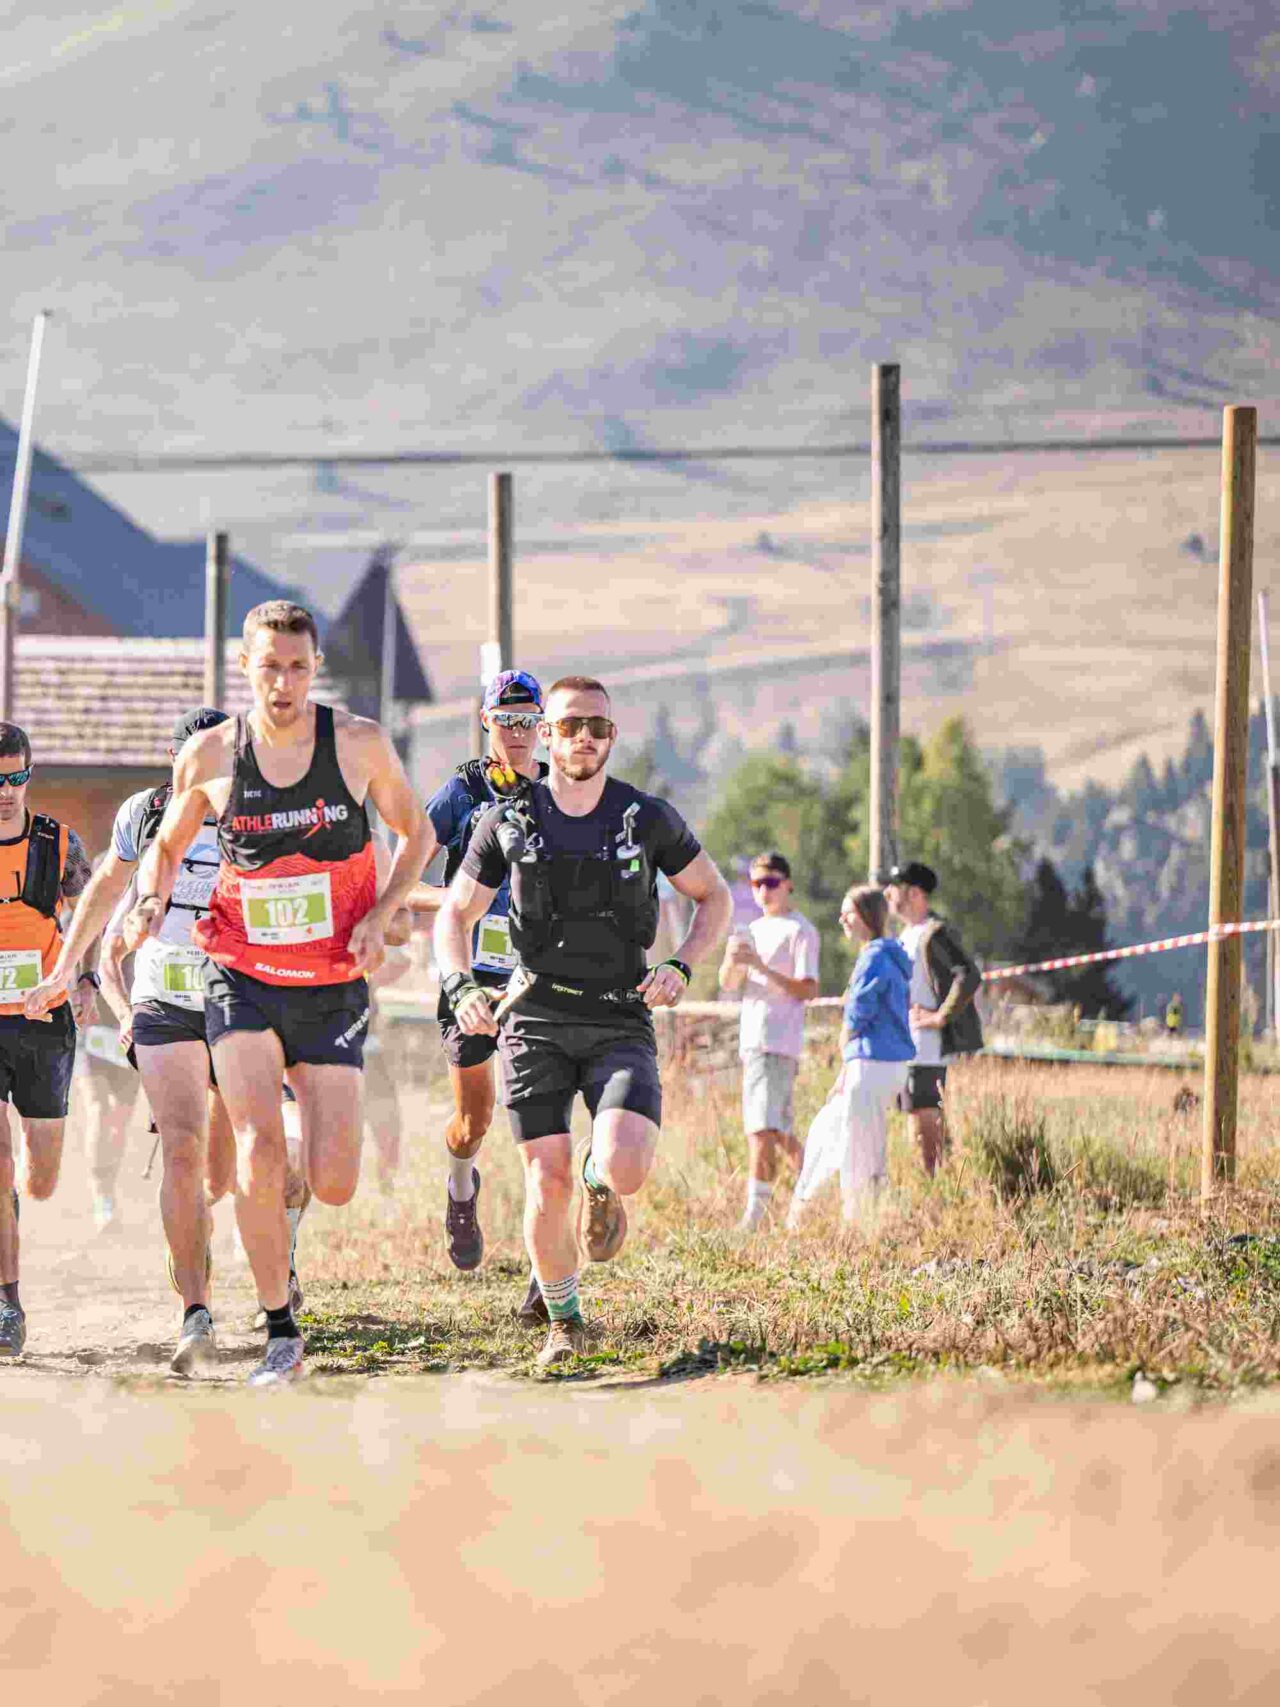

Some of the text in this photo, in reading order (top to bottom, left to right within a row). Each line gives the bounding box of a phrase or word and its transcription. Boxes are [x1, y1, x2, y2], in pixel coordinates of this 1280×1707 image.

[232, 799, 348, 835] ATHLERUNNING
[264, 898, 309, 927] 102
[254, 962, 317, 979] SALOMON
